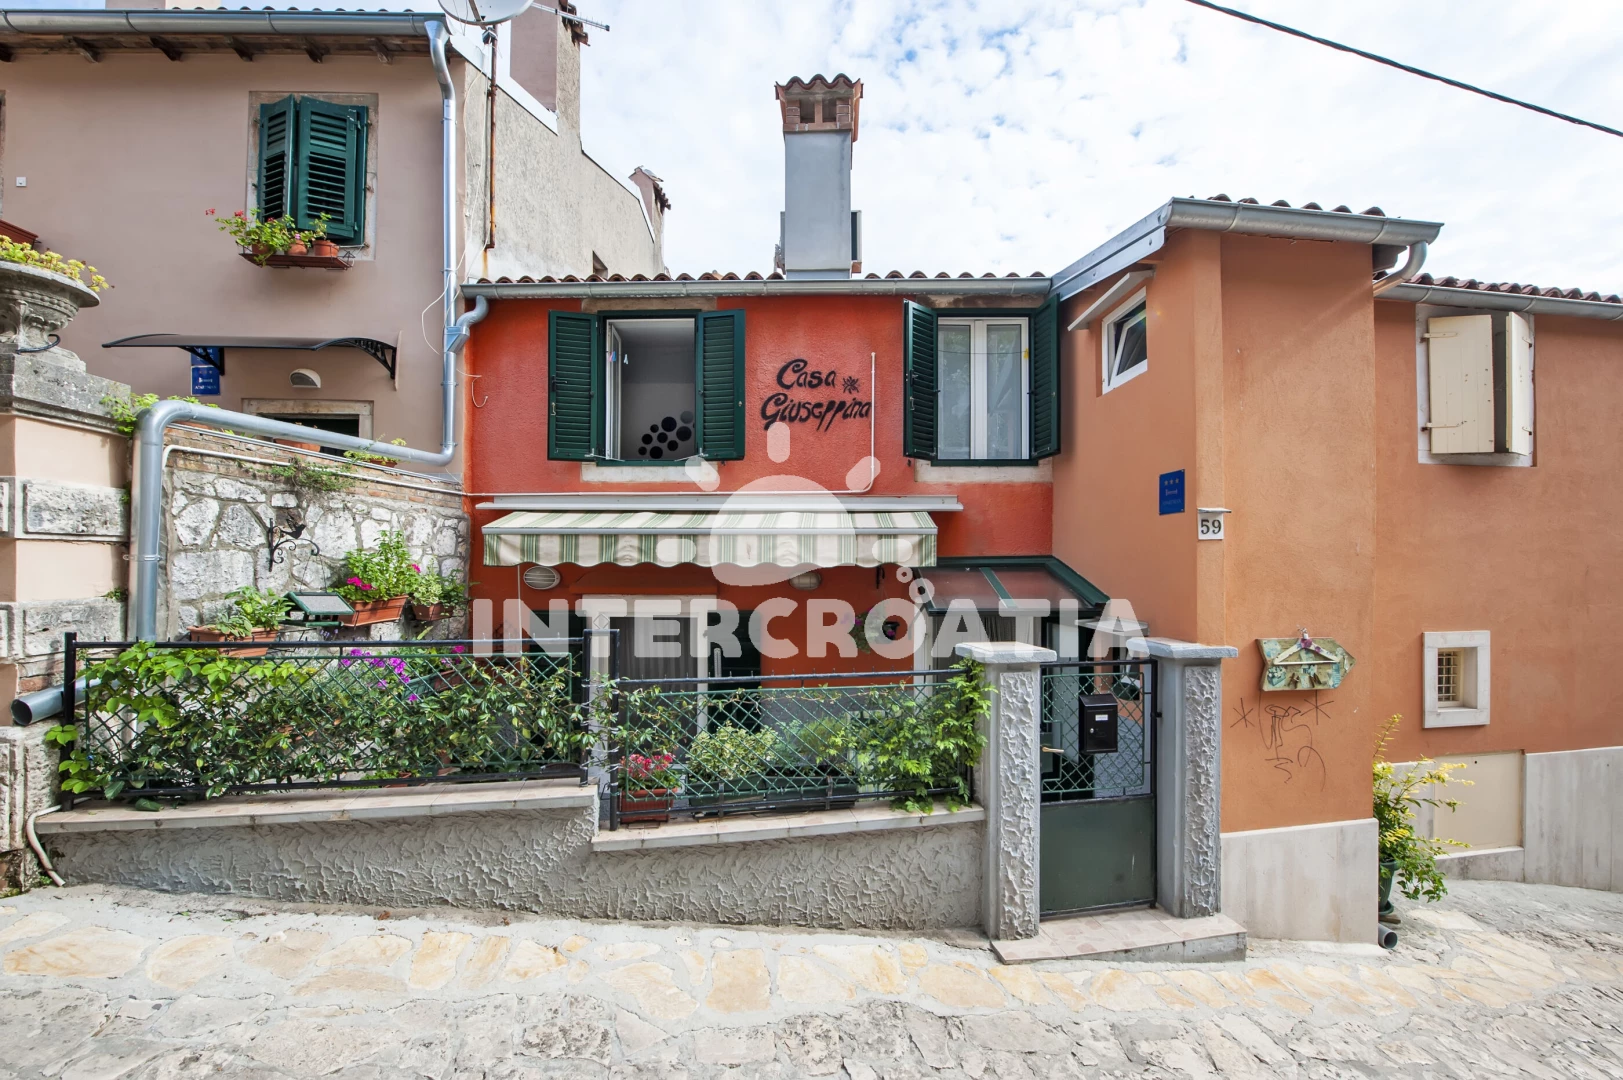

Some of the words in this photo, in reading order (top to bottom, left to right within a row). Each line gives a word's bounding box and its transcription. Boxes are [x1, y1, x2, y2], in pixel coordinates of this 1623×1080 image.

[776, 358, 837, 390] Casa
[761, 392, 872, 432] Giuseppina
[1200, 519, 1222, 535] 59
